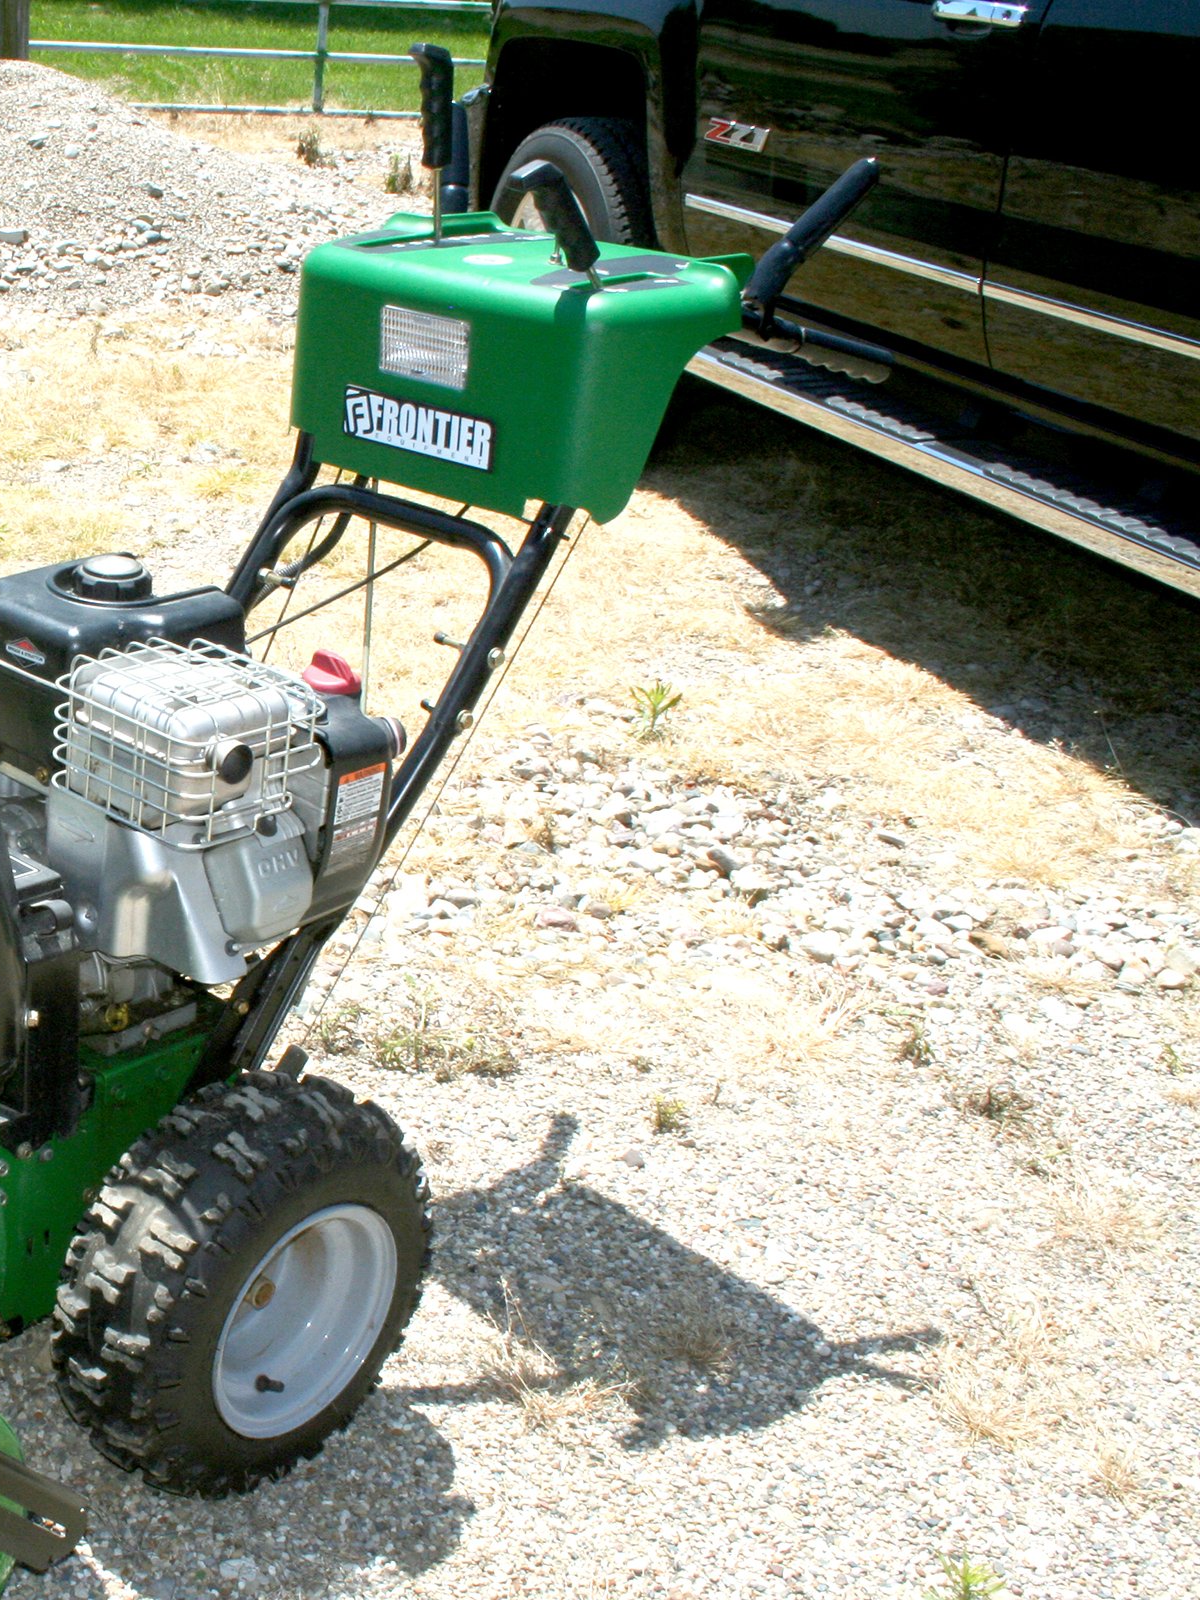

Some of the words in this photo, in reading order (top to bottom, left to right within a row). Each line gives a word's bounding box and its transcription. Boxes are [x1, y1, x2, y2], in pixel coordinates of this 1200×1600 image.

[704, 117, 769, 152] Z71
[369, 394, 491, 458] FRONTIER
[375, 433, 482, 465] EQUIPMENT
